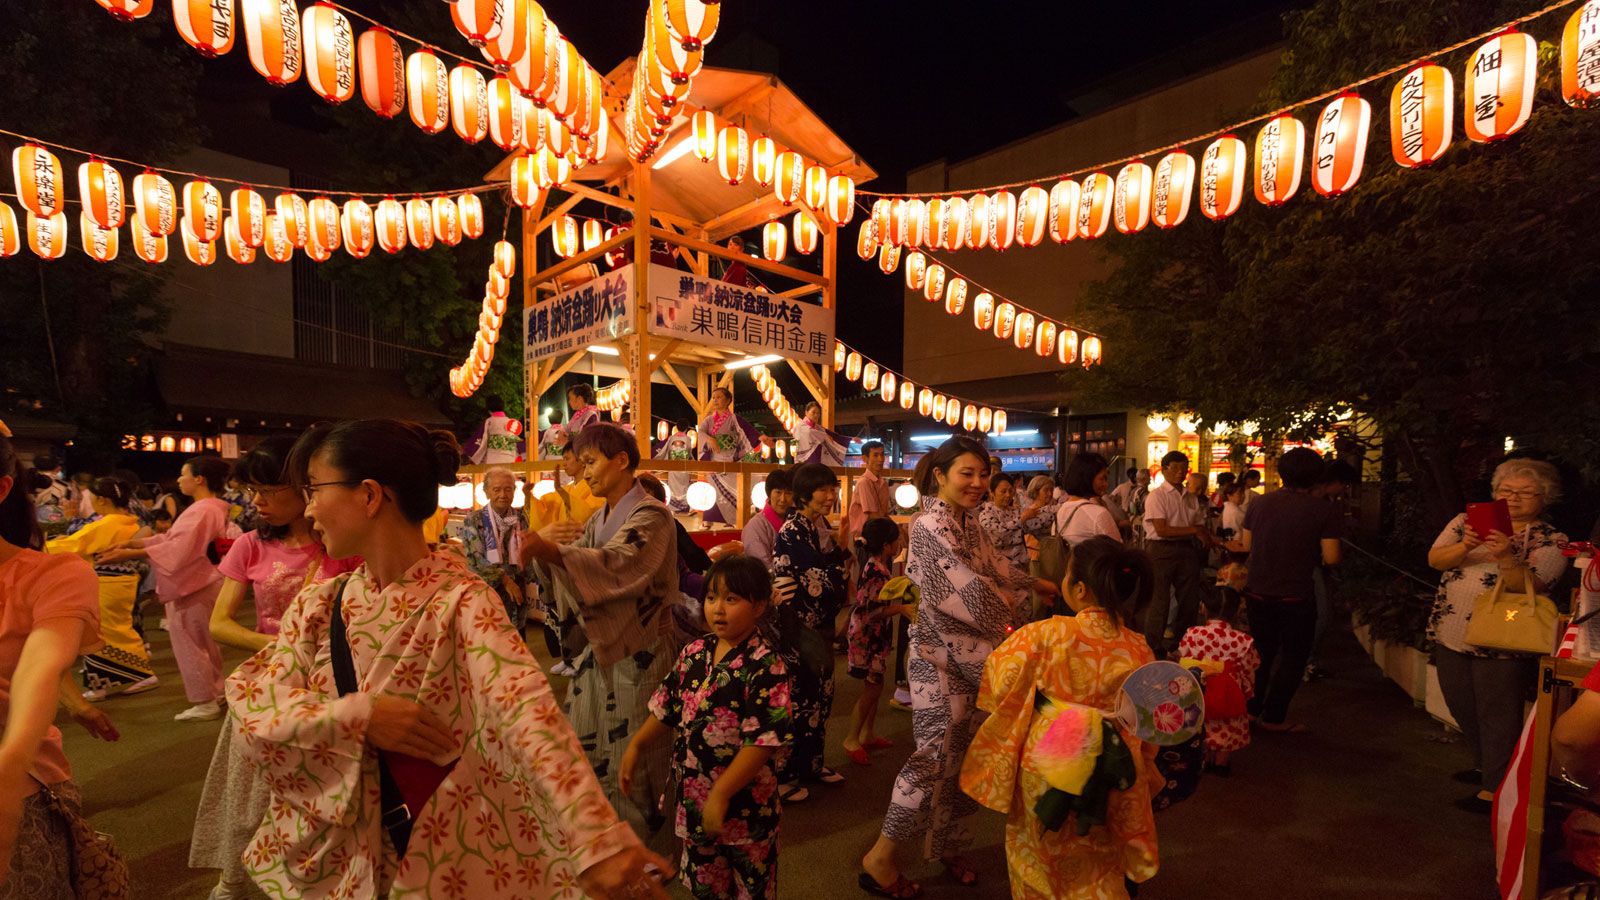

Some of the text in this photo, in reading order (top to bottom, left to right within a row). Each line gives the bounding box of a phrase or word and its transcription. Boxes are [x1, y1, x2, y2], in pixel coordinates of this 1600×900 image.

[1317, 108, 1339, 169] タカセ
[34, 154, 56, 209] 永楽堂
[690, 305, 828, 357] 巣鴨信用金庫
